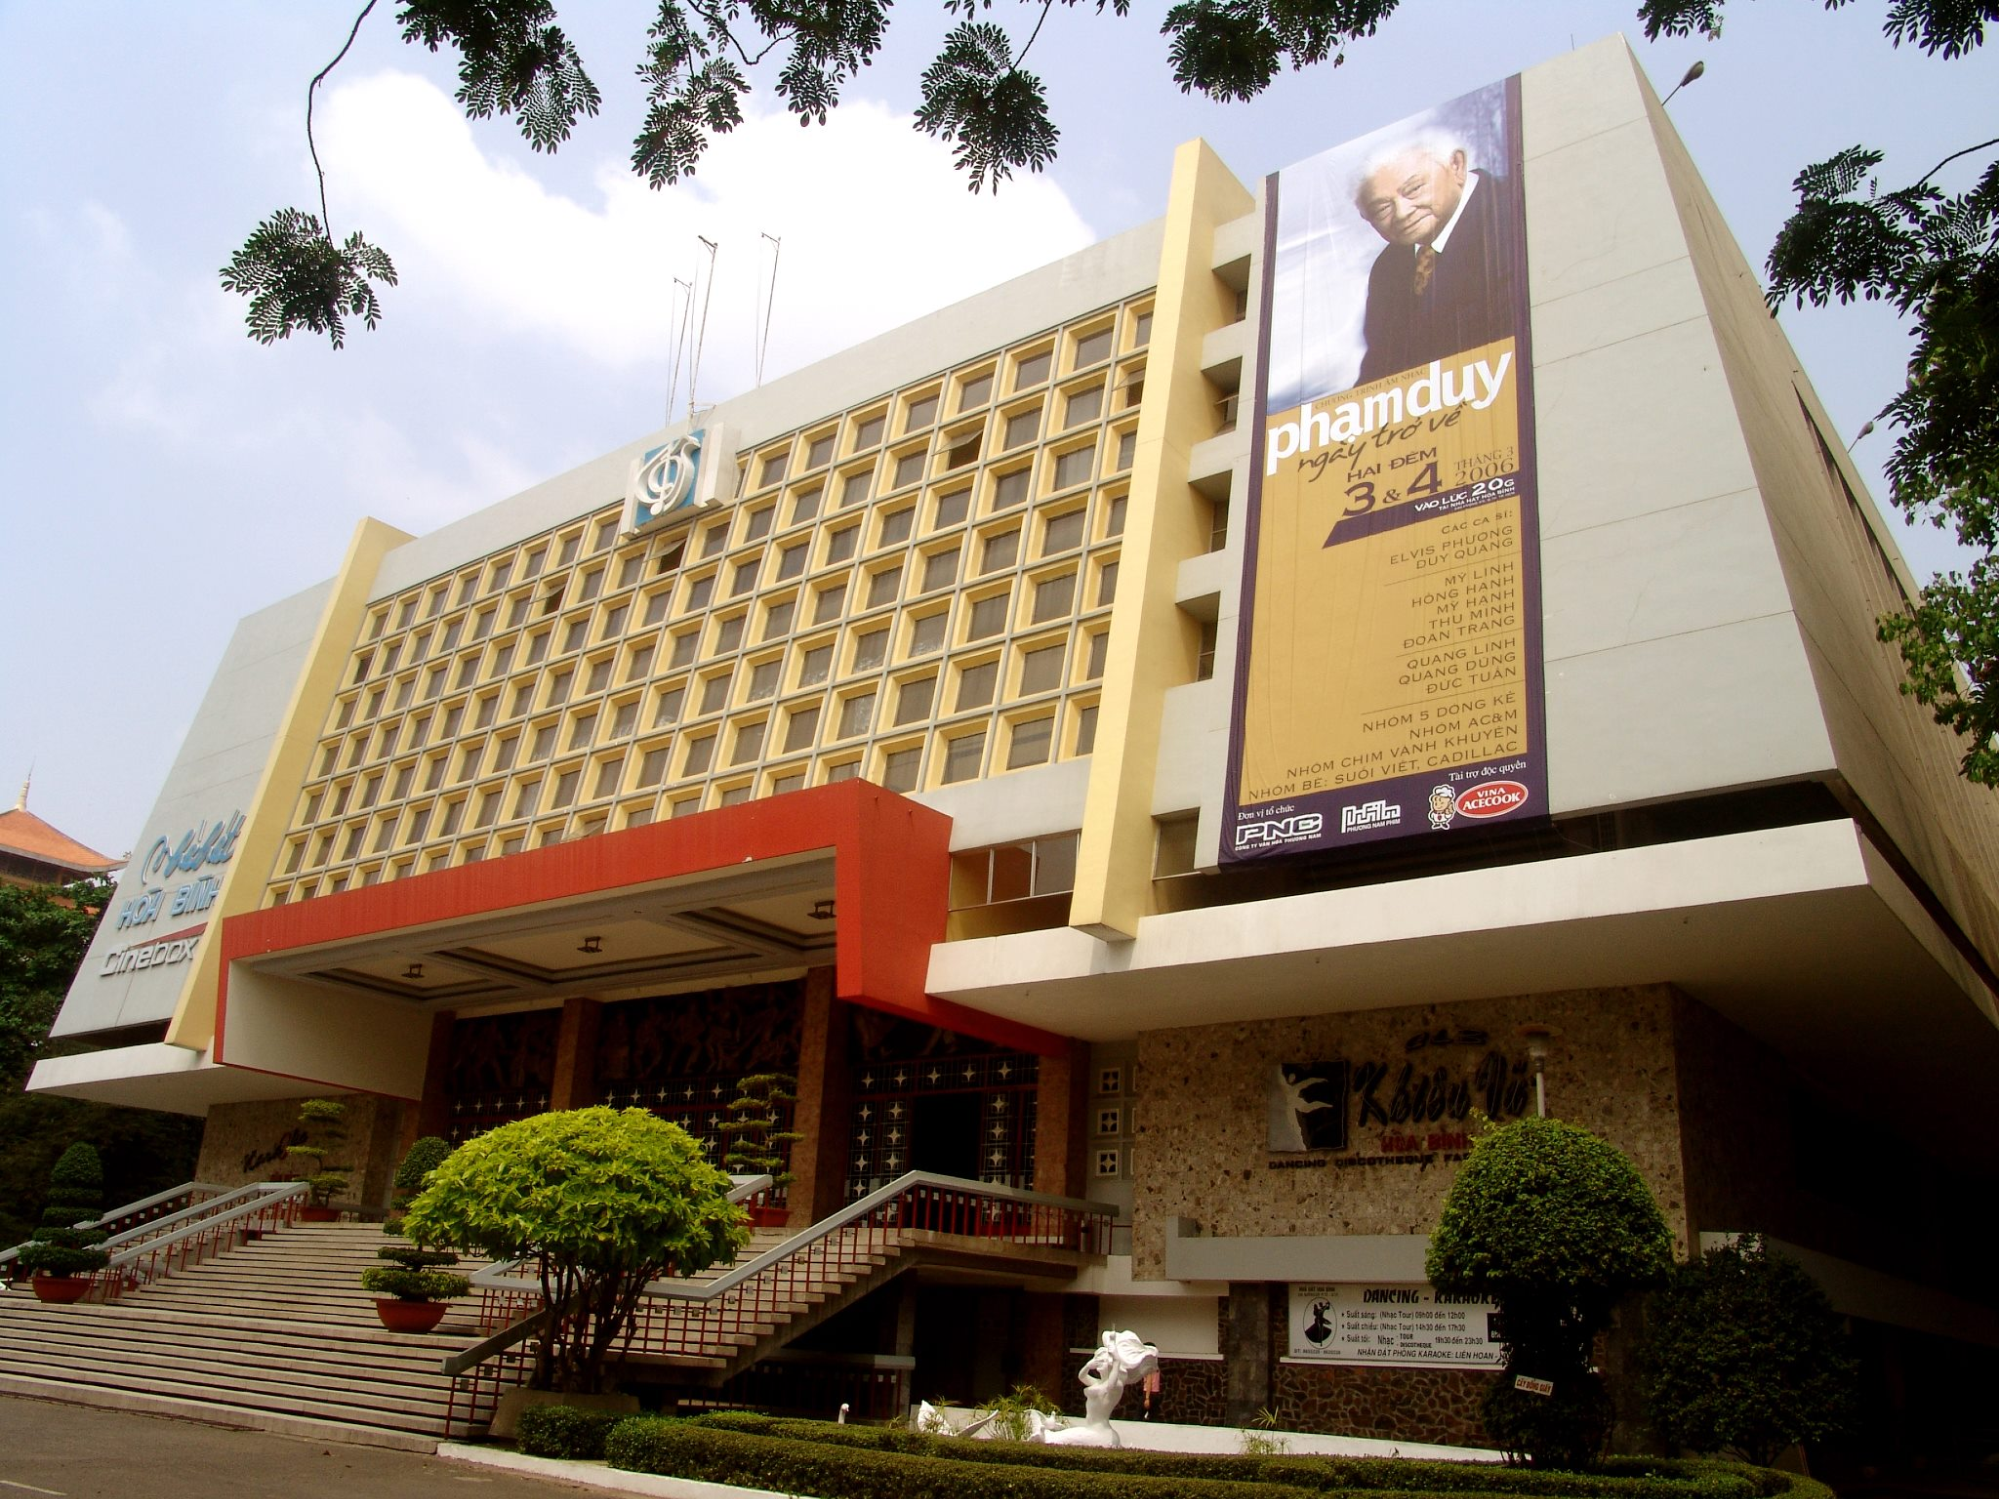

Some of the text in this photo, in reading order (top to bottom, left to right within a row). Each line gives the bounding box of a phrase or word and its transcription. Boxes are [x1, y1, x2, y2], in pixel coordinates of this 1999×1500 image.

[1298, 440, 1365, 483] ngày
[1347, 446, 1438, 484] HAI ĐÊM
[1455, 458, 1514, 487] 2006
[1342, 460, 1443, 517] 3 & 4
[1473, 516, 1490, 526] CA
[1390, 545, 1436, 565] ELVIS
[1454, 537, 1513, 560] QUANG
[1473, 561, 1514, 580] LINH
[1429, 602, 1515, 630] THU MINH
[1457, 615, 1515, 636] TRANG
[1406, 637, 1515, 670] QUANG LINH
[1398, 664, 1459, 685] QUANG
[1420, 710, 1430, 721] 5
[1468, 709, 1517, 729] AC&M
[1341, 751, 1383, 768] CHIM
[1427, 741, 1518, 768] CADILLAC
[1448, 771, 1463, 782] Tài
[1466, 768, 1479, 779] trợ
[1481, 765, 1497, 777] độc
[1463, 792, 1521, 811] ACECOOK
[1477, 787, 1506, 798] VINA
[1386, 818, 1401, 827] PHIM
[100, 937, 199, 977] Cinebox
[1269, 1158, 1327, 1170] DANCING
[1335, 1153, 1434, 1167] DISCOTHEQUE
[1363, 1289, 1420, 1304] DANCING
[1447, 1311, 1466, 1320] 12h00
[1473, 1352, 1494, 1360] HOAN
